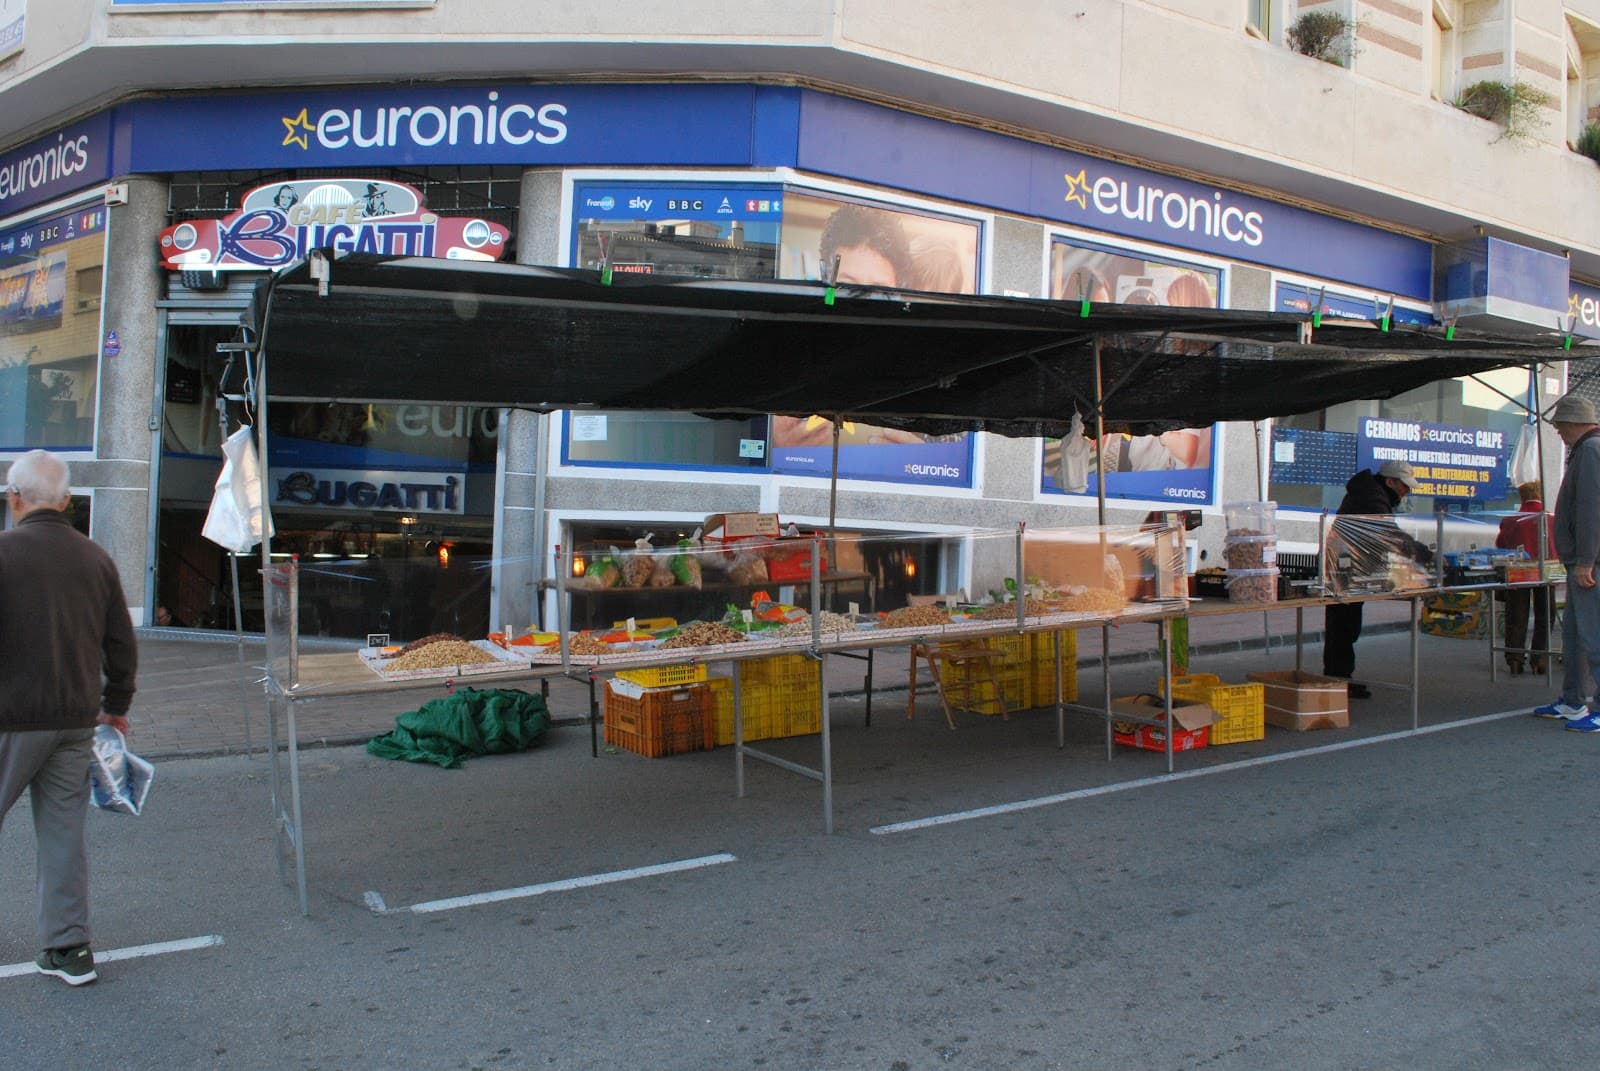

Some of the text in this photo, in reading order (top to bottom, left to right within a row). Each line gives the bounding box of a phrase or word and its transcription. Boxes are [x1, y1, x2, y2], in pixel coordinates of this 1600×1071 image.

[317, 91, 567, 149] euronics
[0, 133, 88, 199] euronics
[629, 196, 653, 212] sky
[668, 200, 703, 210] BBC
[1092, 176, 1264, 247] euronics
[290, 201, 365, 226] CAFÉ
[20, 232, 33, 248] sky
[40, 226, 58, 242] BBC
[1365, 419, 1503, 449] CERRAMOS euronics CALPE
[1408, 450, 1418, 462] EN
[911, 463, 960, 478] euronics
[1169, 487, 1207, 499] euronics
